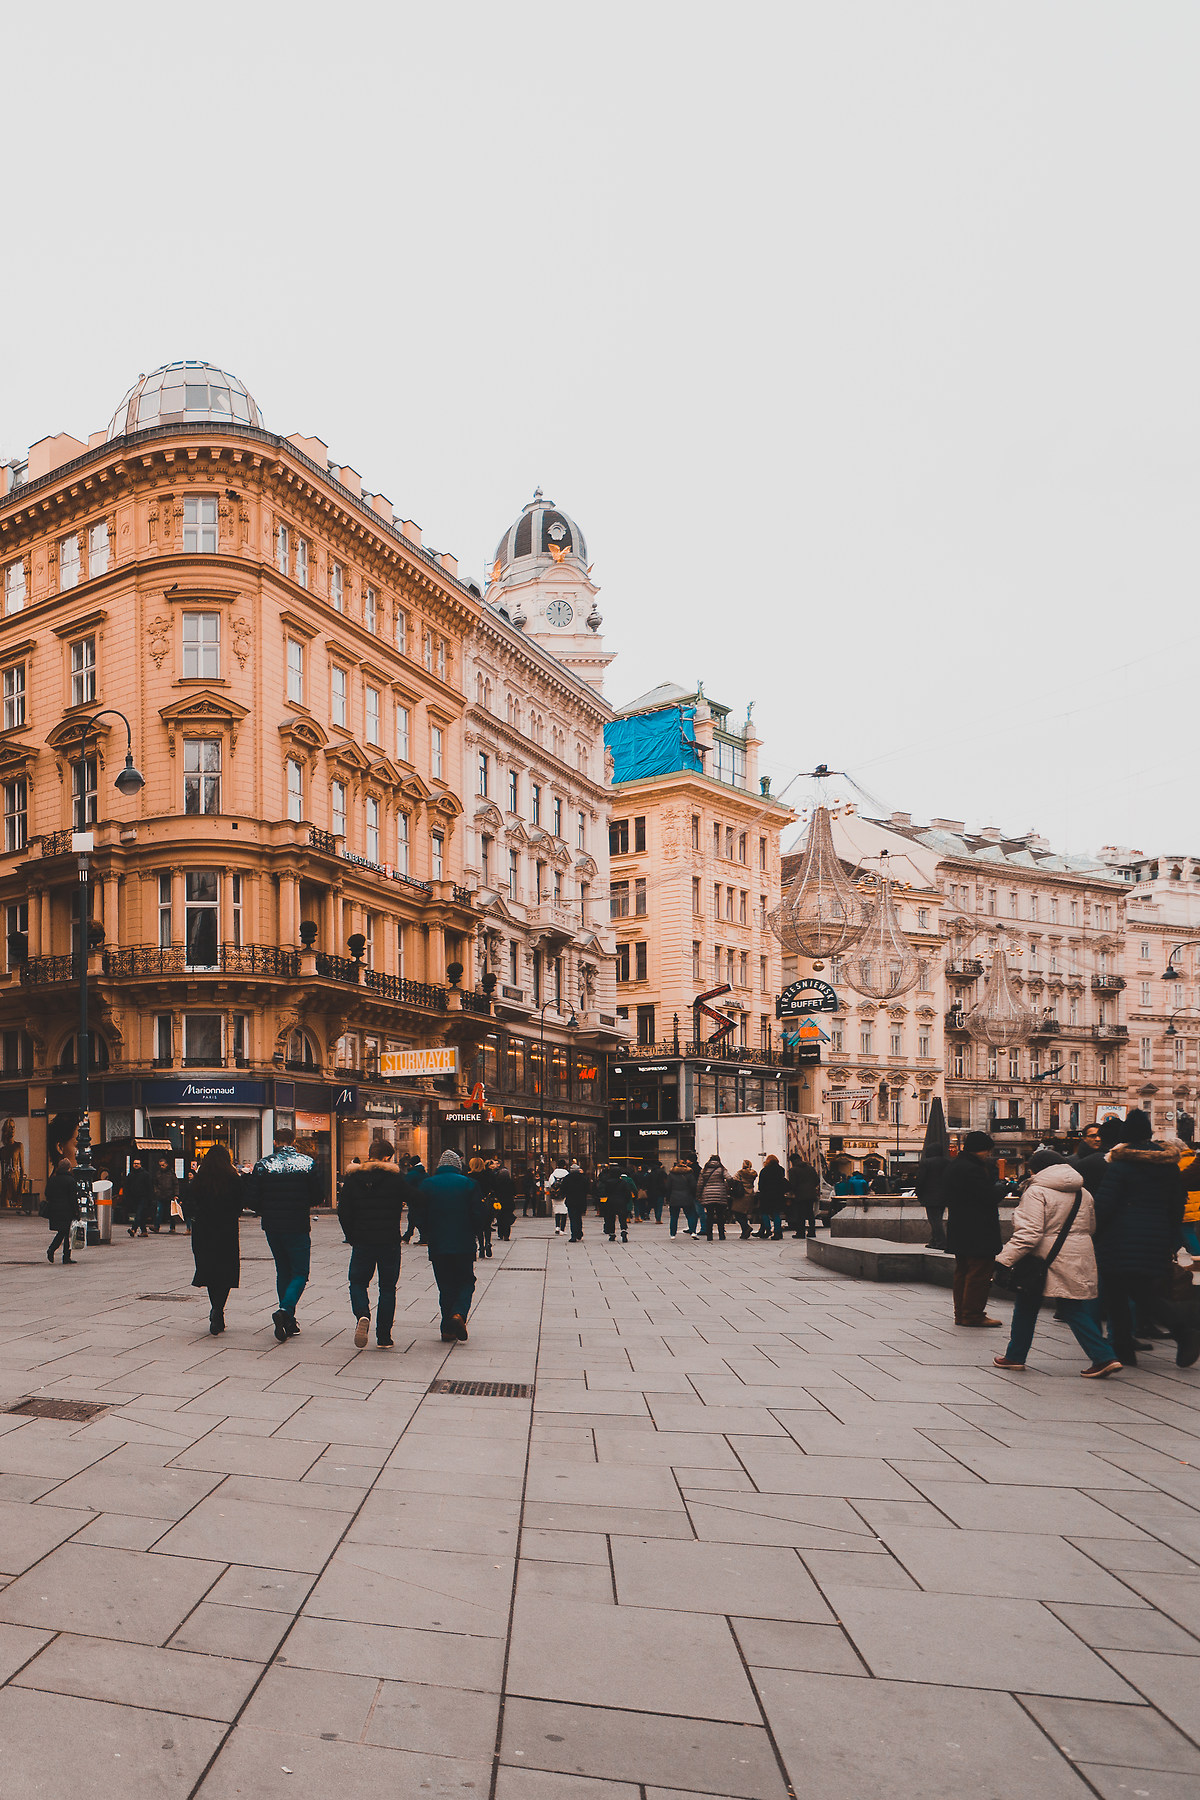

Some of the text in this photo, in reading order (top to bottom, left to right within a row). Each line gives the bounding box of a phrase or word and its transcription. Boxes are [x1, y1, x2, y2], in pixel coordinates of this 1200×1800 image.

[781, 980, 835, 1008] TRZESNIEWSKI
[790, 999, 824, 1009] BUFFET
[385, 1050, 451, 1071] STURMAYR
[182, 1084, 235, 1097] Marionnaud
[446, 1113, 482, 1121] APOTHEKE
